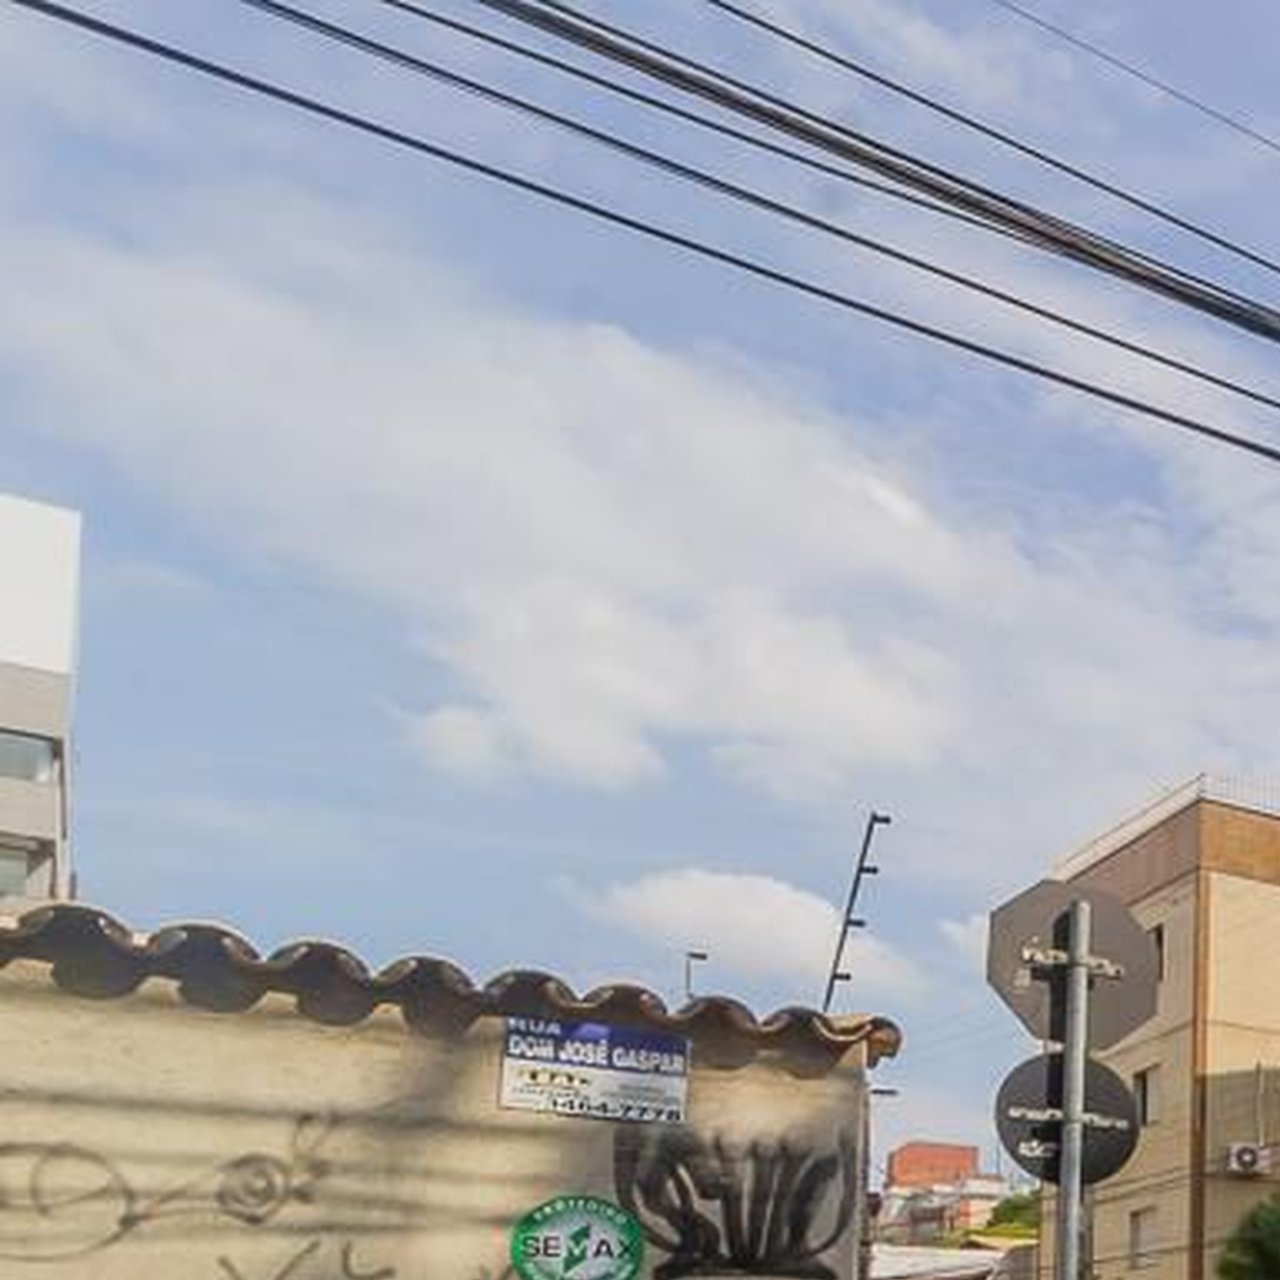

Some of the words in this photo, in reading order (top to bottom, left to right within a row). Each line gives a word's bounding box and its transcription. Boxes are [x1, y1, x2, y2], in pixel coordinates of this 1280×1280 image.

[508, 1018, 562, 1036] RUA
[508, 1034, 555, 1059] DOM
[557, 1038, 609, 1066] JOSÉ
[612, 1047, 686, 1074] GASPAR
